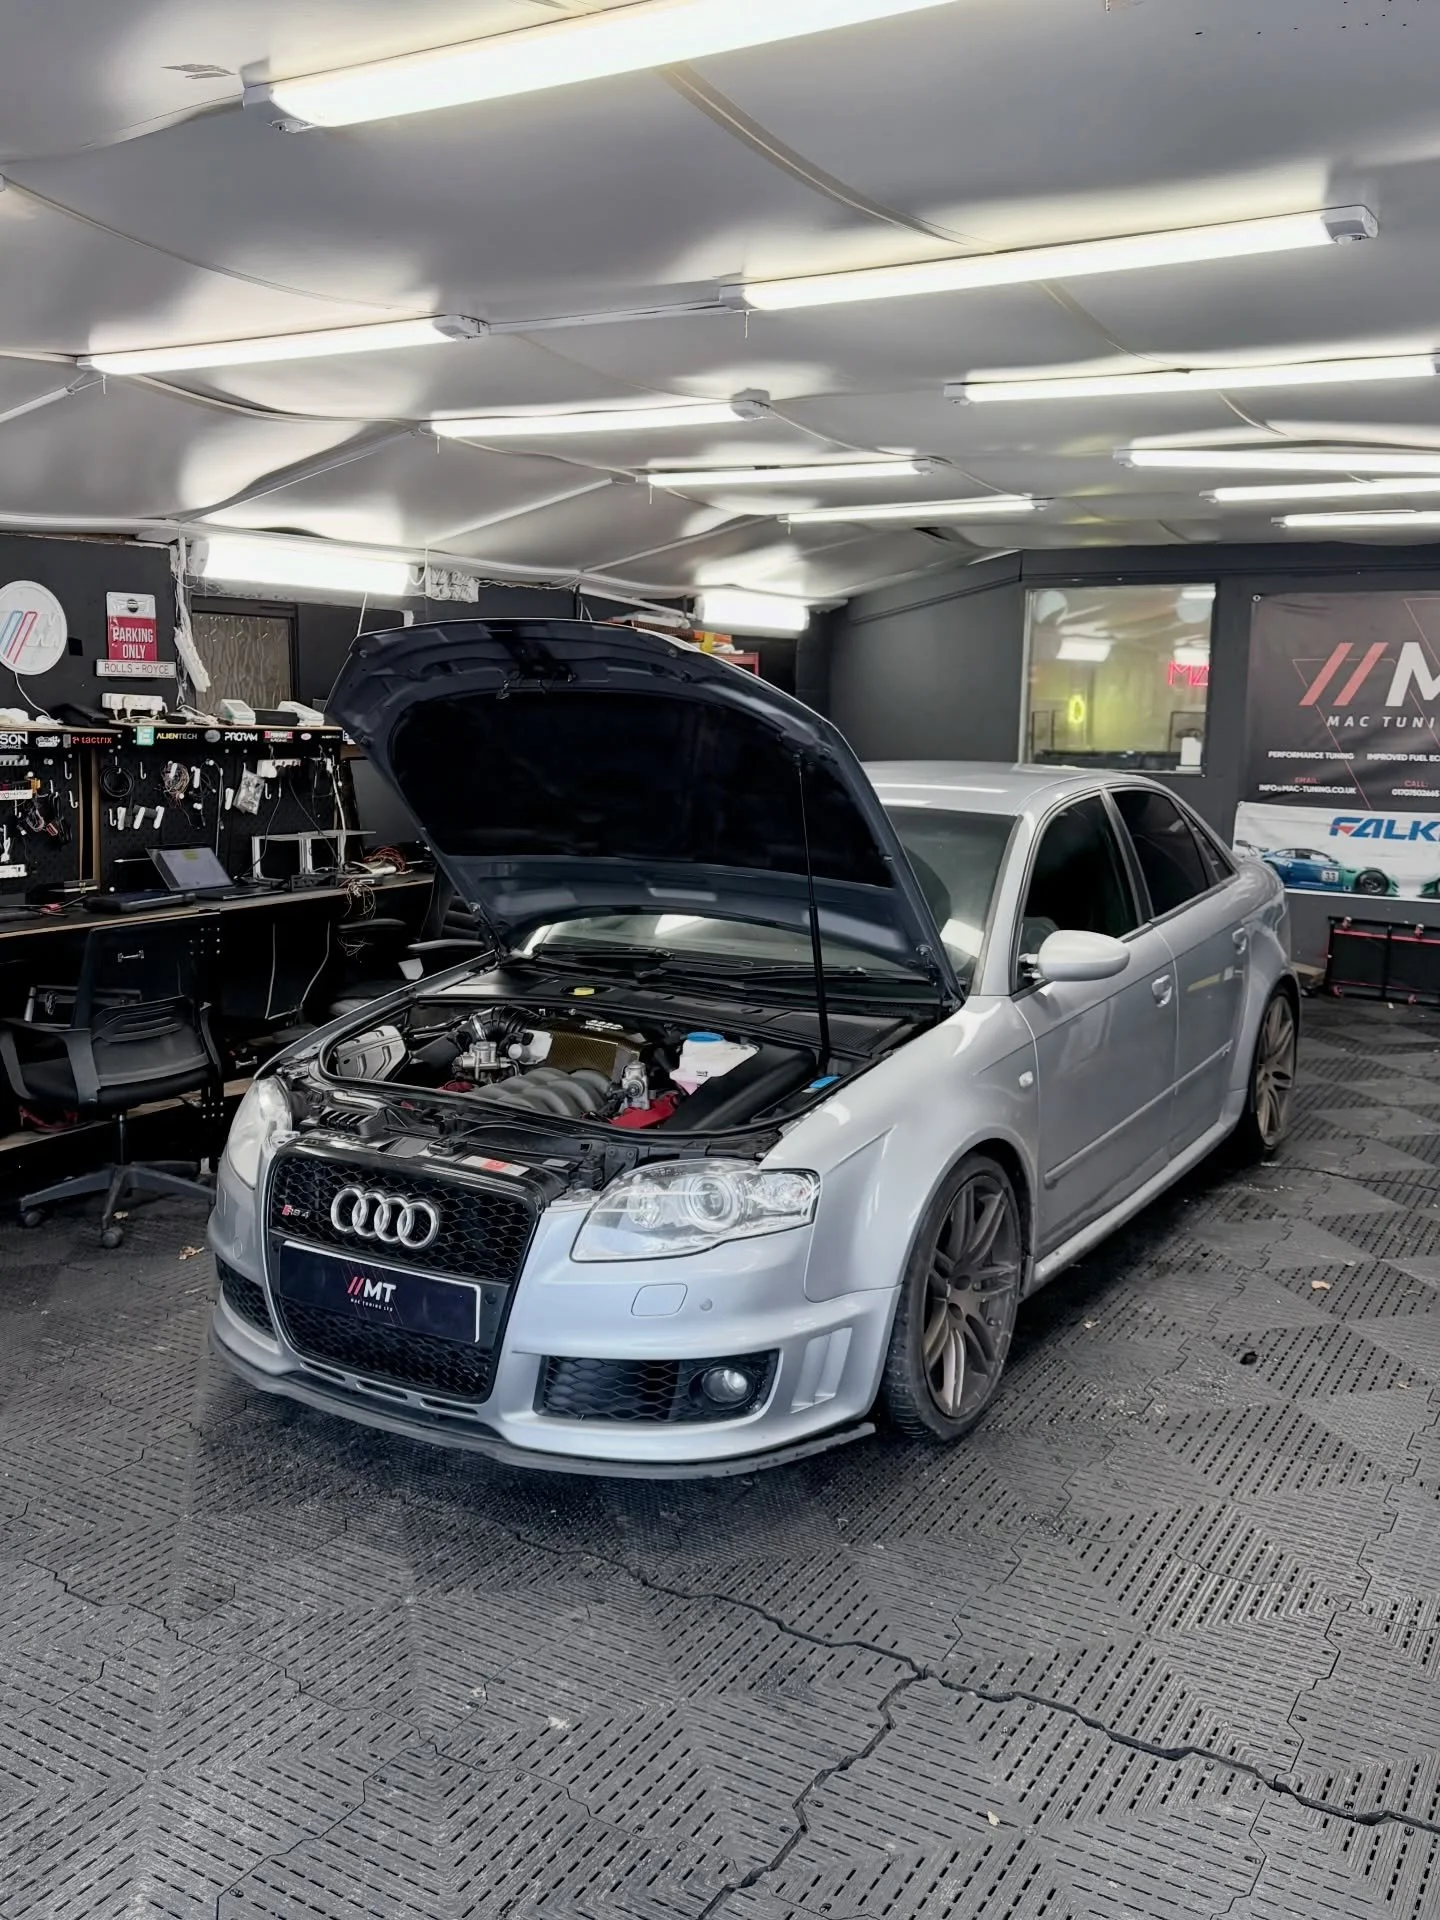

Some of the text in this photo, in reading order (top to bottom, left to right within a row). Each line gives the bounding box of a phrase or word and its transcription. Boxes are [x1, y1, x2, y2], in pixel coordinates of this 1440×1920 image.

[112, 627, 154, 643] PARKING
[122, 644, 146, 659] ONLY
[1326, 715, 1371, 728] MAC
[81, 735, 113, 745] tactrix
[156, 732, 198, 741] ALIENTECH
[1268, 750, 1355, 761] PERFORMANCE TUNING
[1366, 752, 1408, 762] IMPROVED
[1408, 754, 1428, 762] FUEL
[1329, 816, 1440, 842] FALK
[1324, 871, 1337, 882] 33
